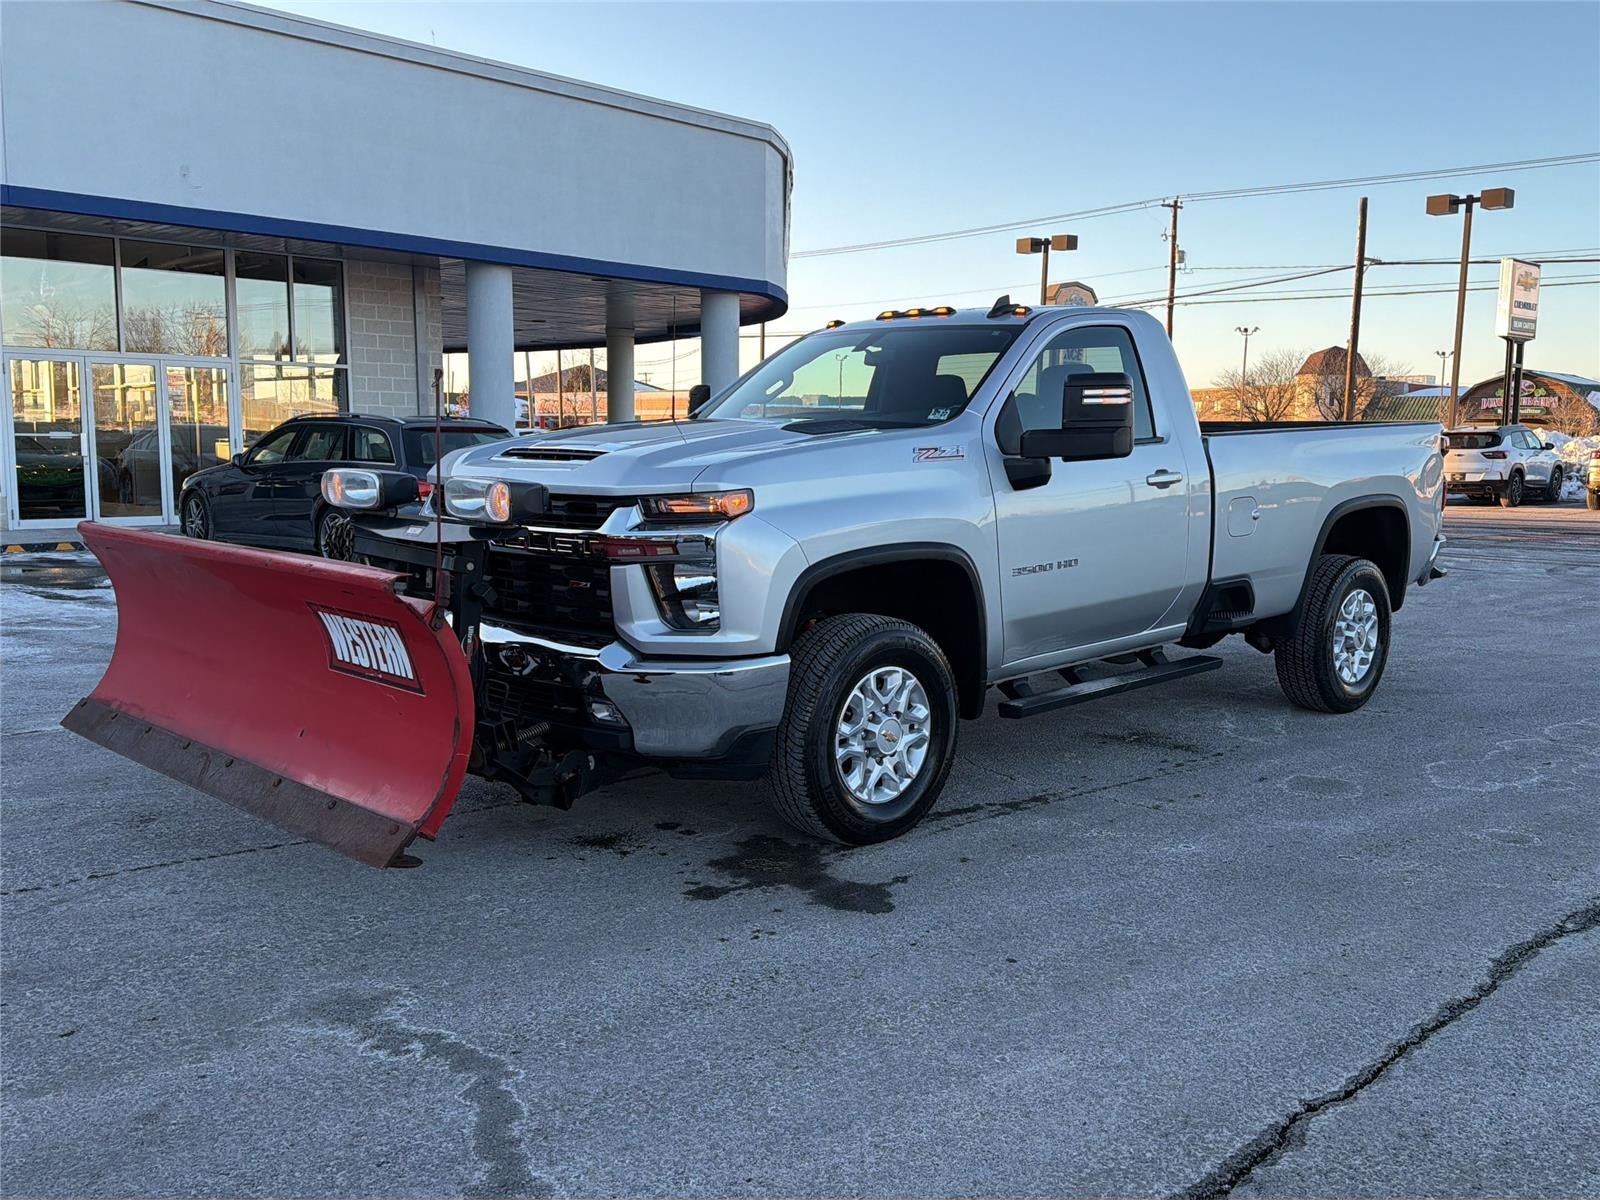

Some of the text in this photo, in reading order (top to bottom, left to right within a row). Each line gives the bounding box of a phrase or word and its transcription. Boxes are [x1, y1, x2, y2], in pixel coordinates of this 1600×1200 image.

[913, 445, 965, 463] Z71
[1012, 558, 1079, 577] 3500 HD
[318, 611, 414, 680] WESTERN
